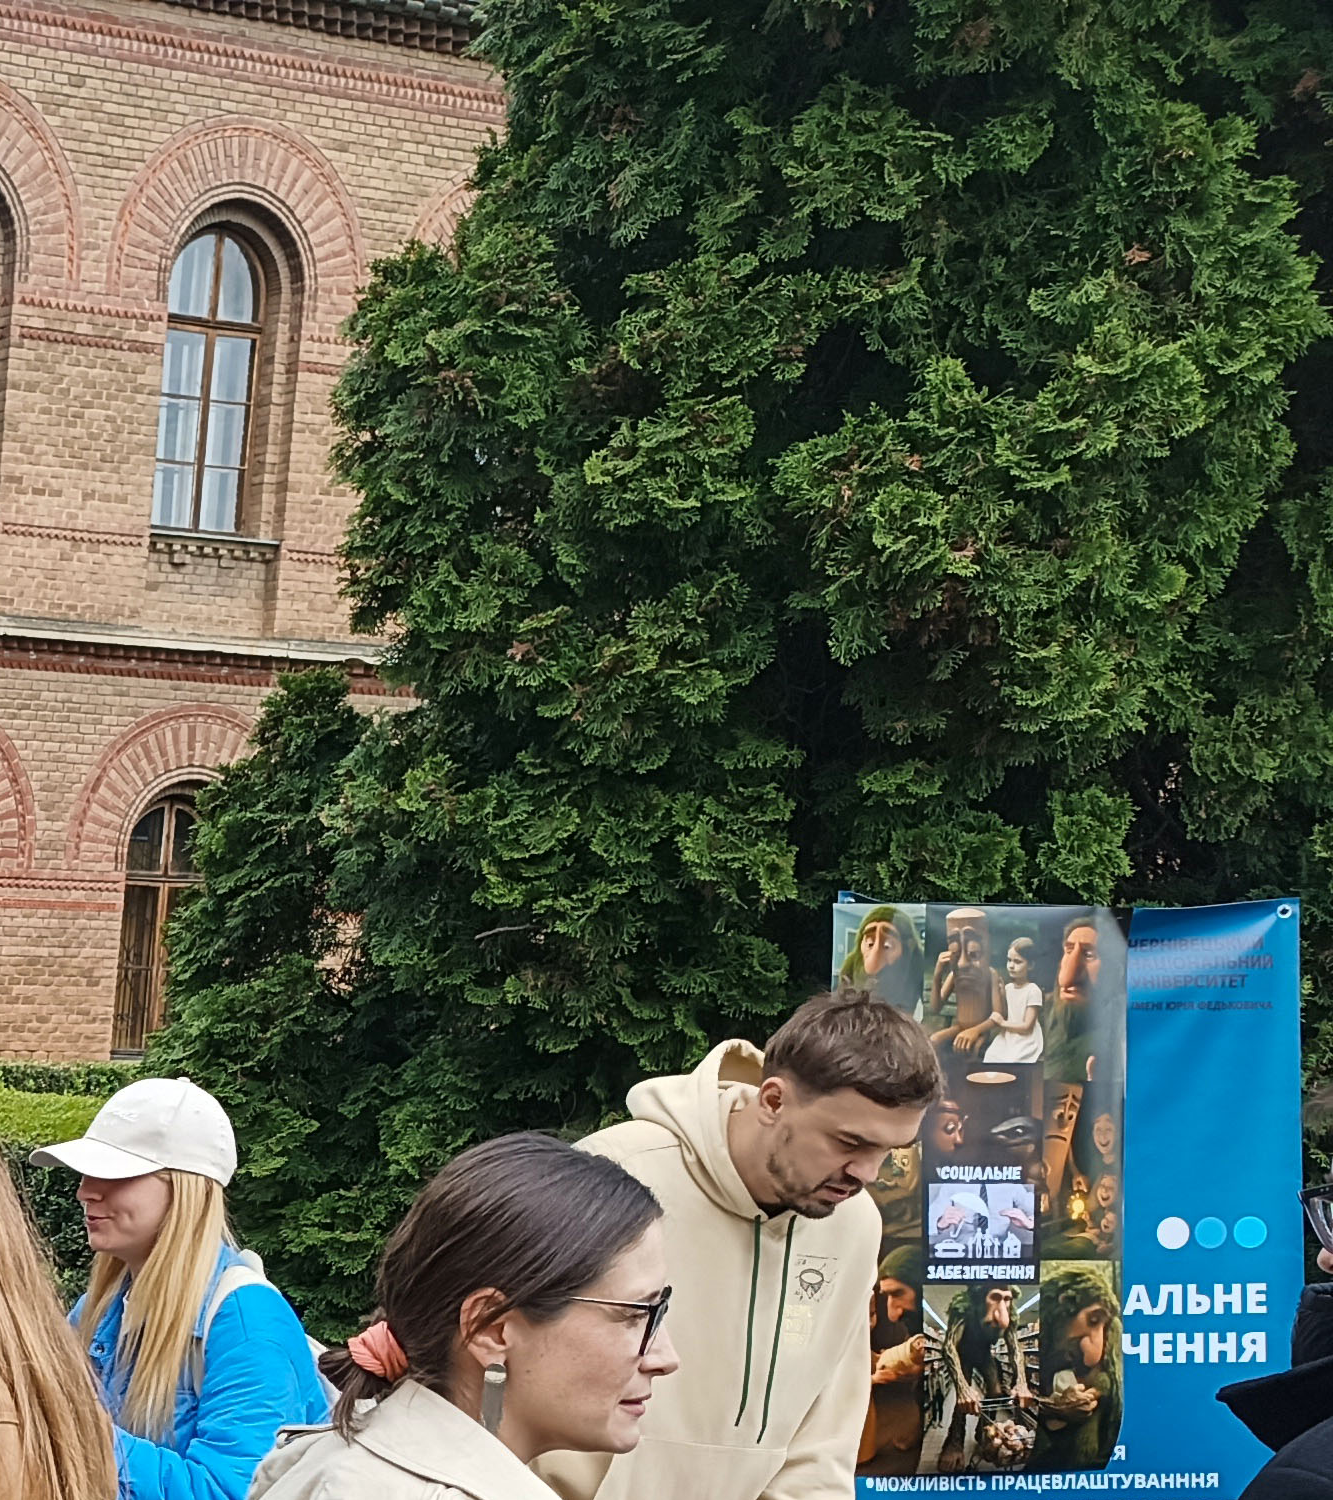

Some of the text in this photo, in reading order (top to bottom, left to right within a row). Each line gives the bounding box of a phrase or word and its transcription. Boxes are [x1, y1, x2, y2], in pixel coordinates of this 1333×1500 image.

[939, 1165, 1023, 1182] СОЦІАЛЬНЕ
[926, 1264, 1036, 1280] ЗАБЕЗПЕЧЕННЯ
[875, 1474, 987, 1492] МОЖЛИВІСТЬ
